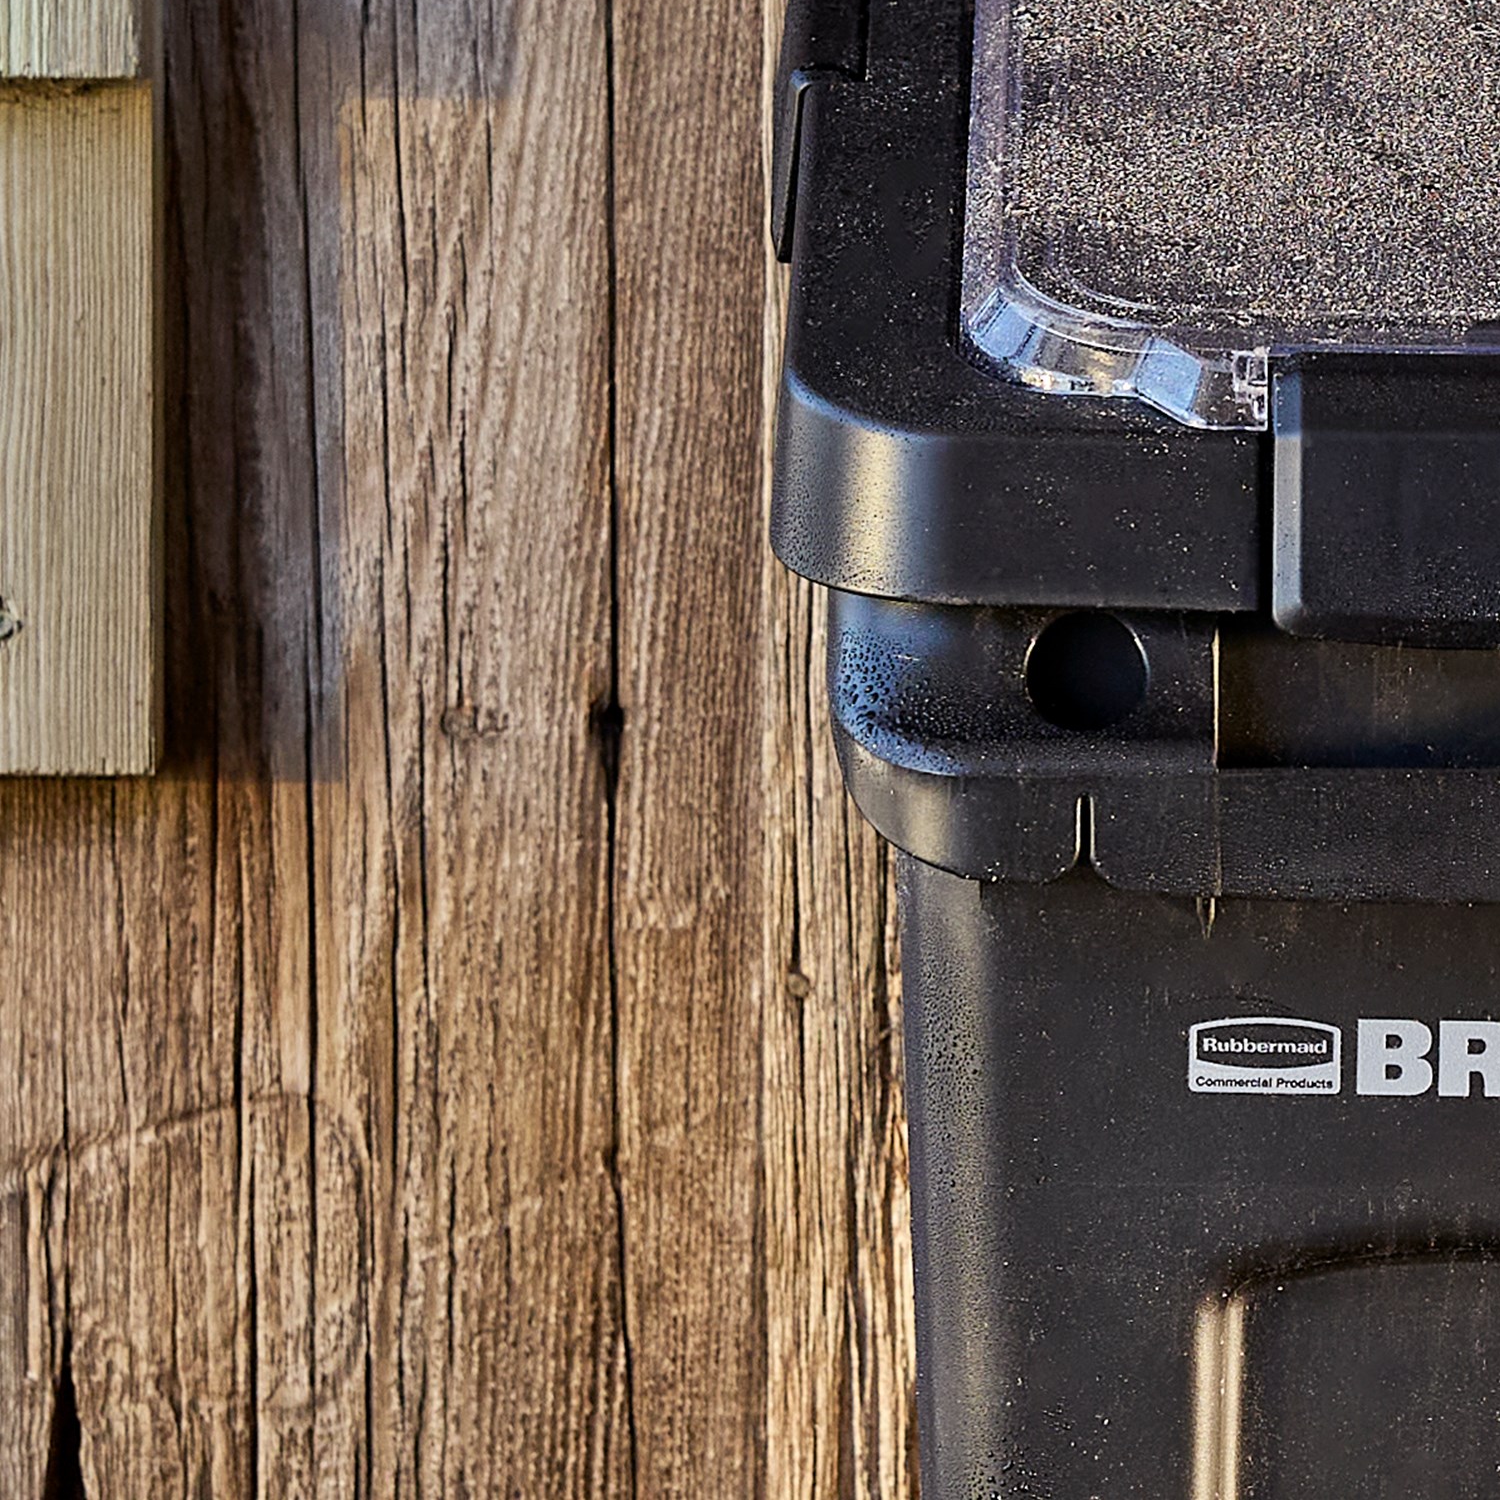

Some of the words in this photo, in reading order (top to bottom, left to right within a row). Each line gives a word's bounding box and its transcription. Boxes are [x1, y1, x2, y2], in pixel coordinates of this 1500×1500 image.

[1202, 1037, 1328, 1054] Rubbermaid
[1195, 1075, 1272, 1088] Commercial
[1276, 1077, 1334, 1089] Products
